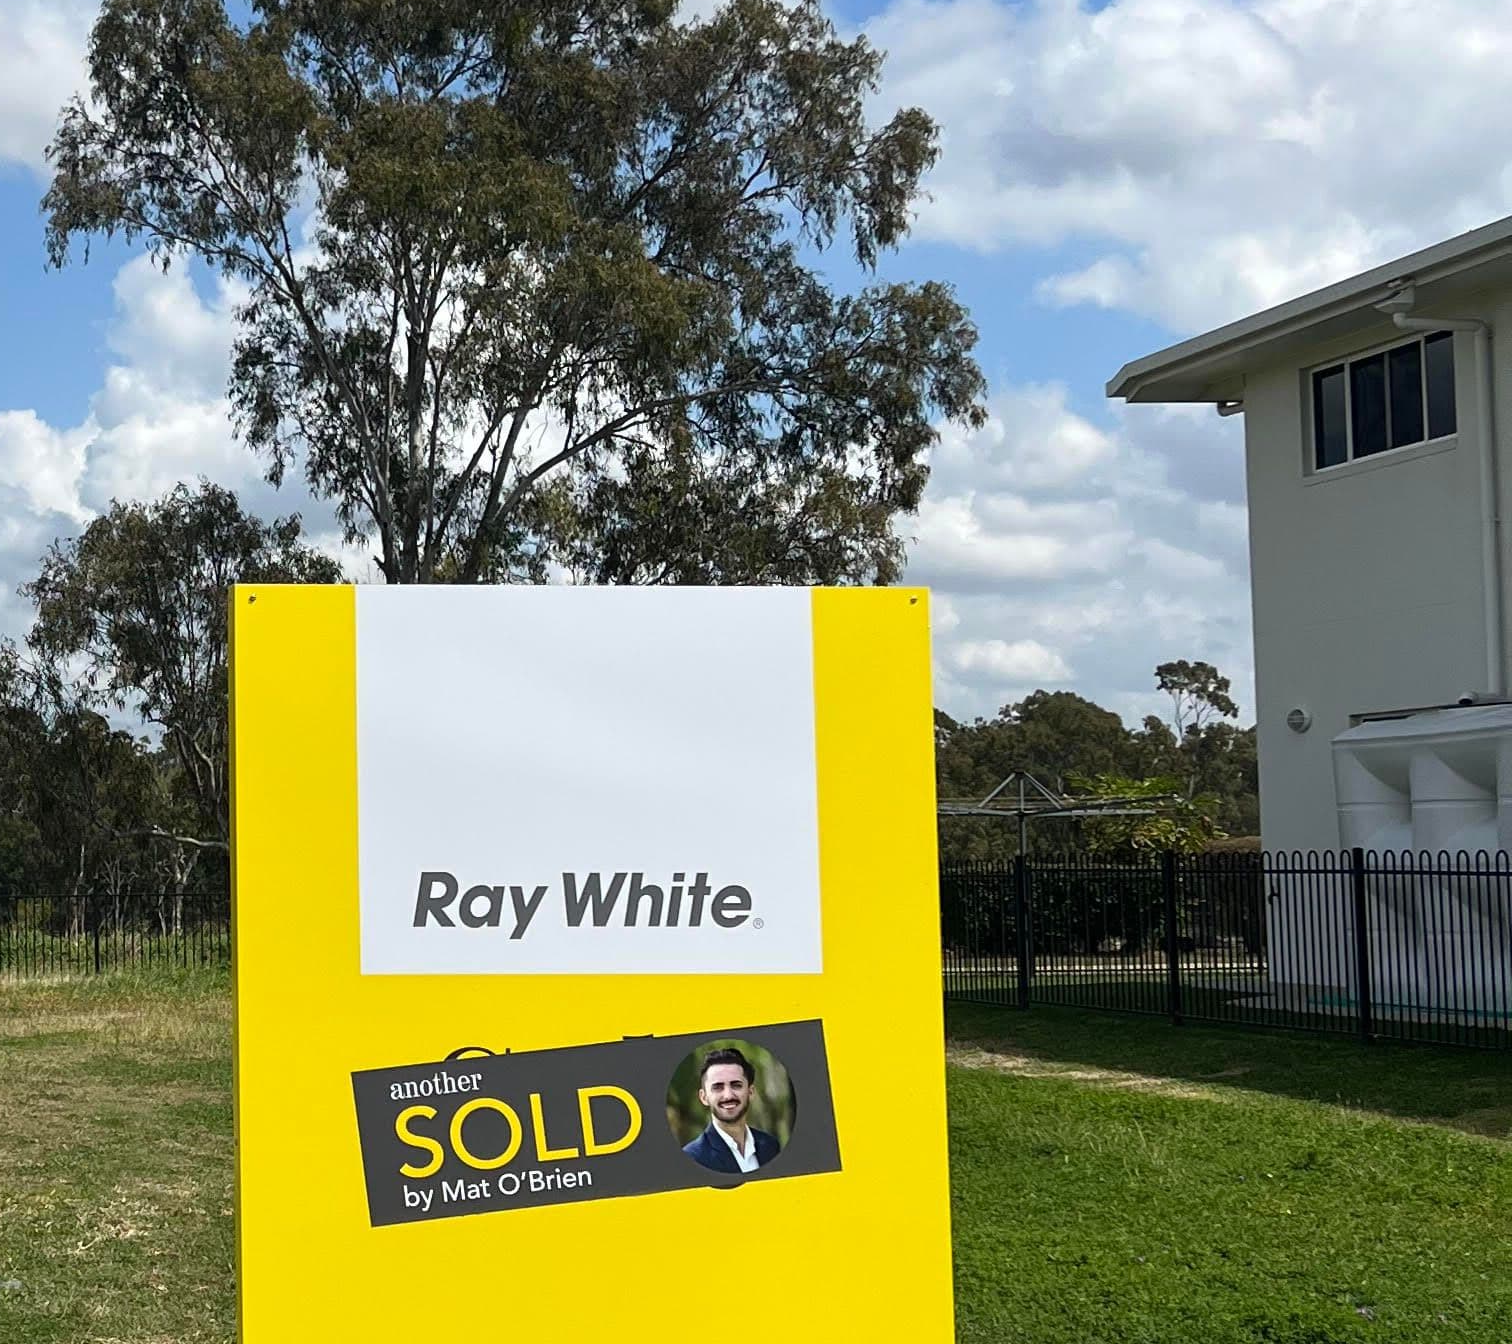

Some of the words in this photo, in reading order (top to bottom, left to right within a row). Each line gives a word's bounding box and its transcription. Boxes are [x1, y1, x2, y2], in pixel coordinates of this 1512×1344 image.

[413, 872, 549, 940] Ray
[390, 1071, 482, 1101] another
[395, 1086, 642, 1178] SOLD
[404, 1184, 434, 1212] by
[442, 1179, 492, 1203] Mat
